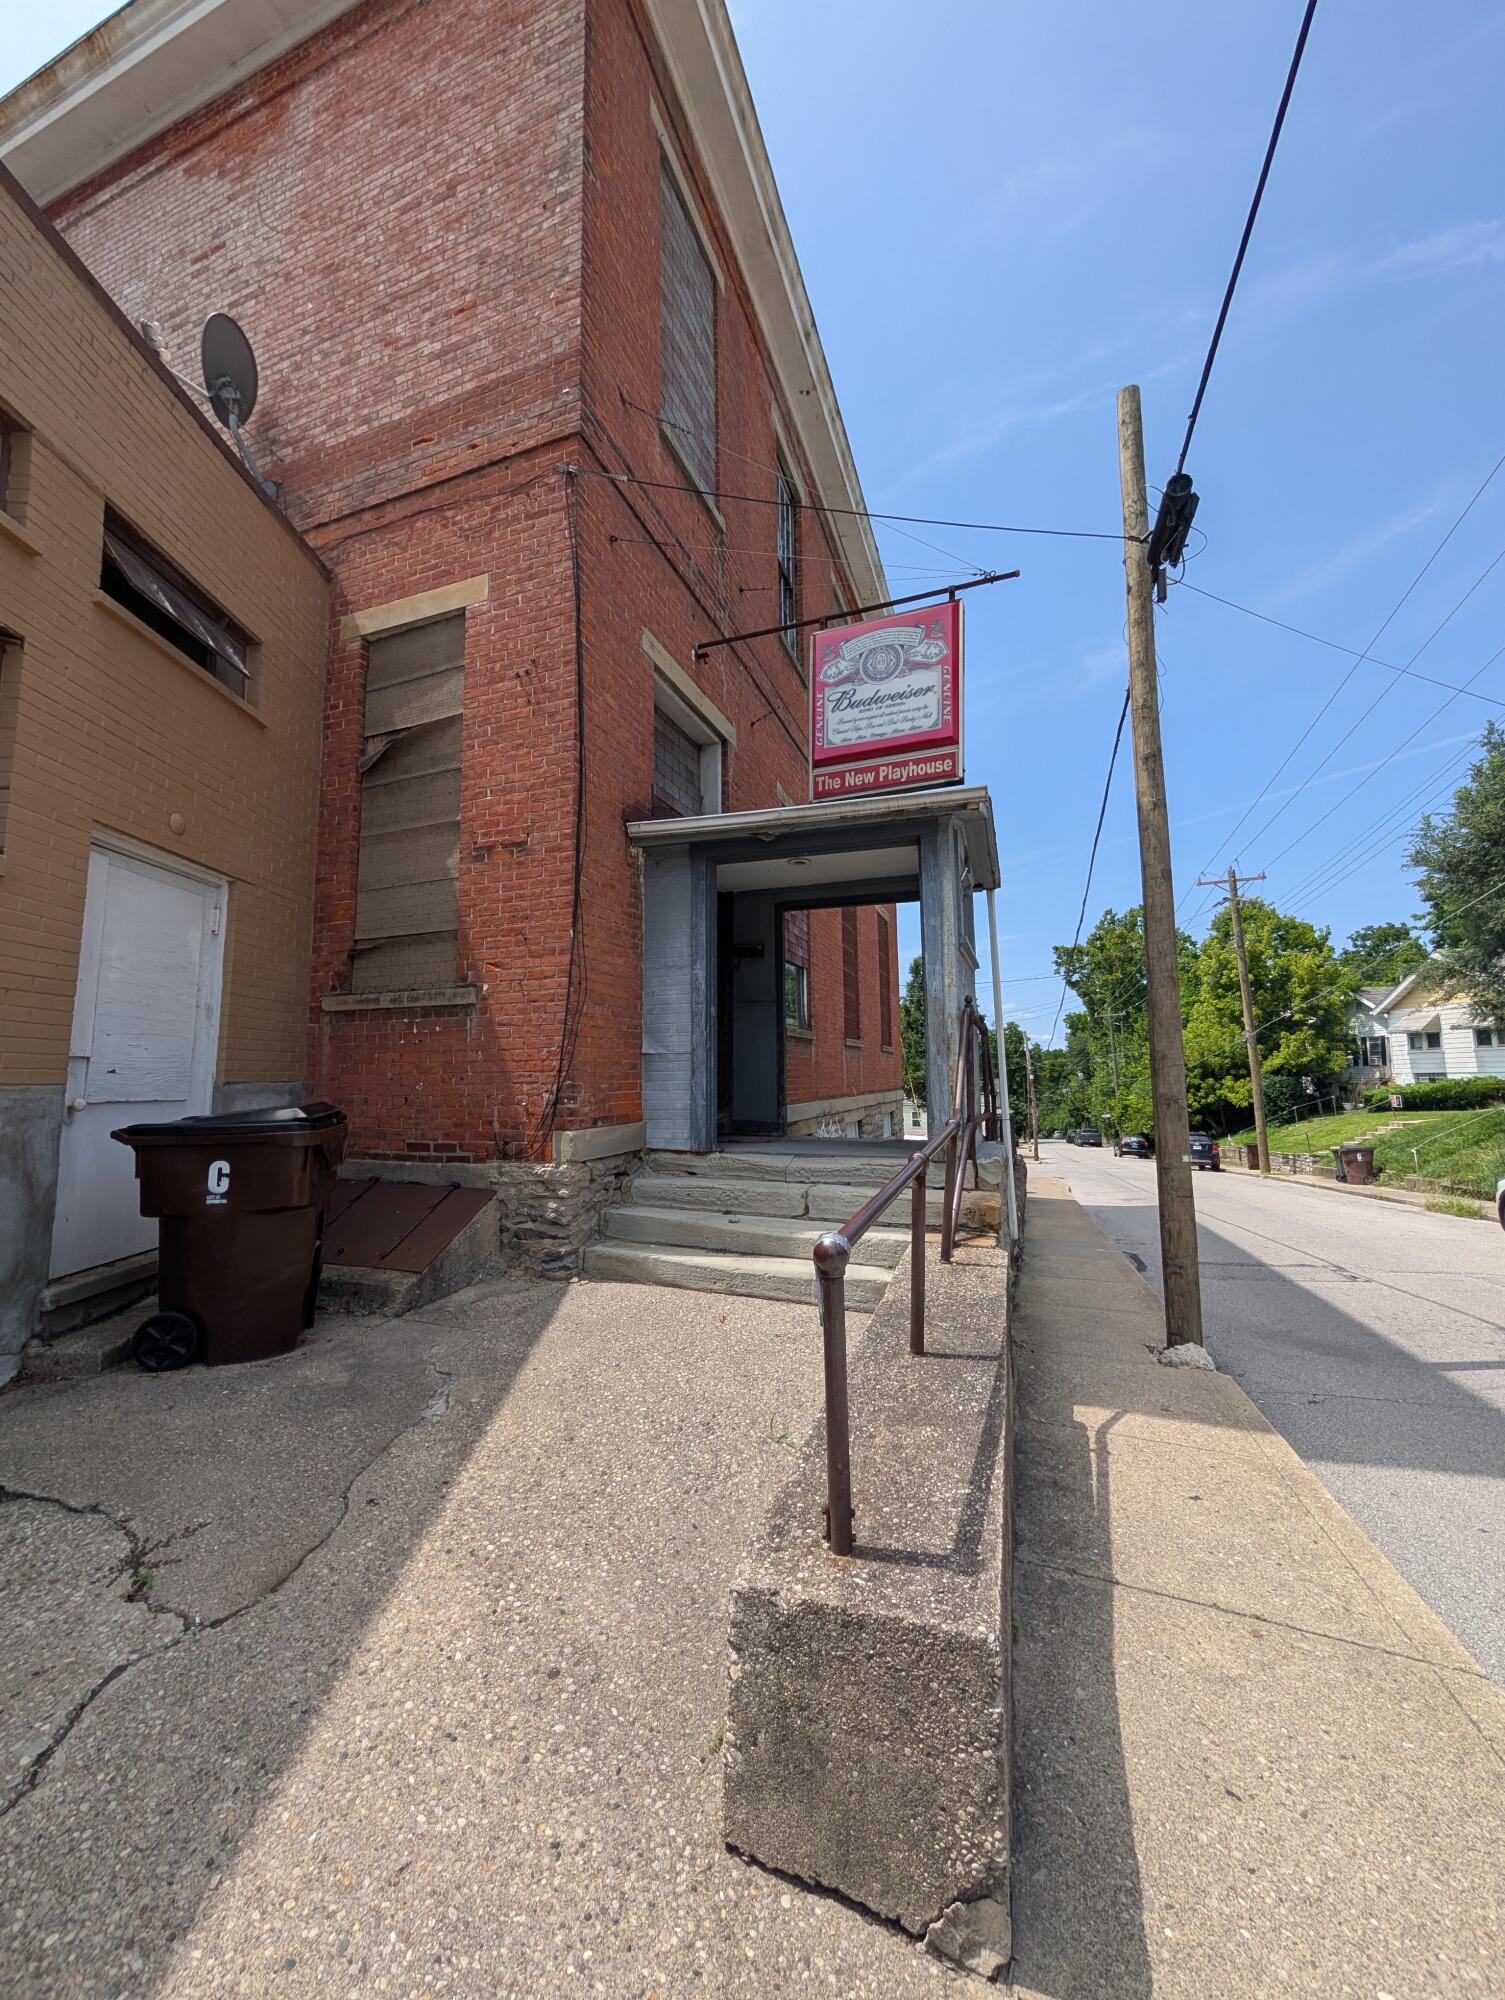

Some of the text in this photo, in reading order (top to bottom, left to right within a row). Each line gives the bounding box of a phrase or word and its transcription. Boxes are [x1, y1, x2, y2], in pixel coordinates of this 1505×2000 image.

[827, 684, 936, 713] Budweiser
[943, 665, 952, 723] GENUINE
[816, 690, 824, 746] GENUINE
[816, 758, 953, 791] The New Playhouse
[208, 1160, 230, 1194] C
